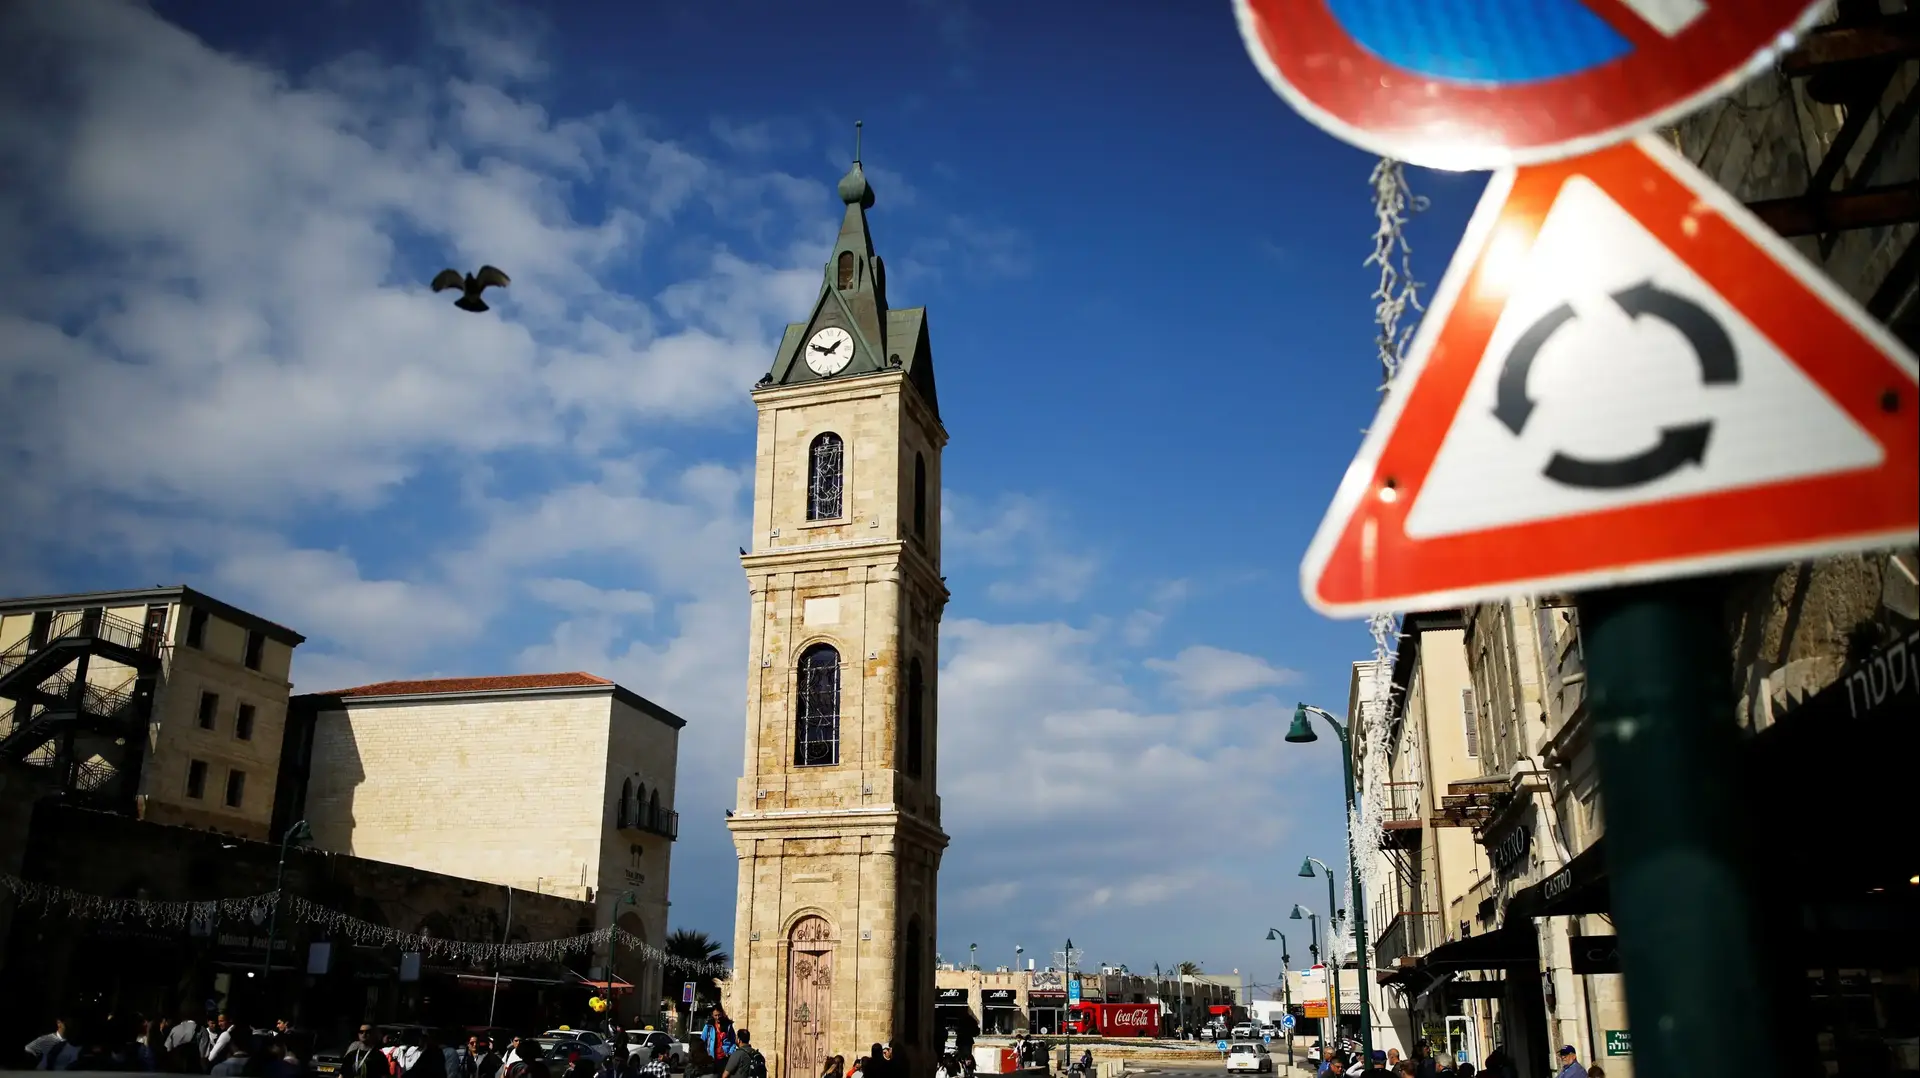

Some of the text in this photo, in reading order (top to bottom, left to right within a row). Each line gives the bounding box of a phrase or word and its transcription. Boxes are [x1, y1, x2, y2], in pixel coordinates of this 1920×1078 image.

[1494, 826, 1524, 872] CASTRO
[1544, 868, 1572, 900] CASTRO
[252, 935, 287, 950] Restrant
